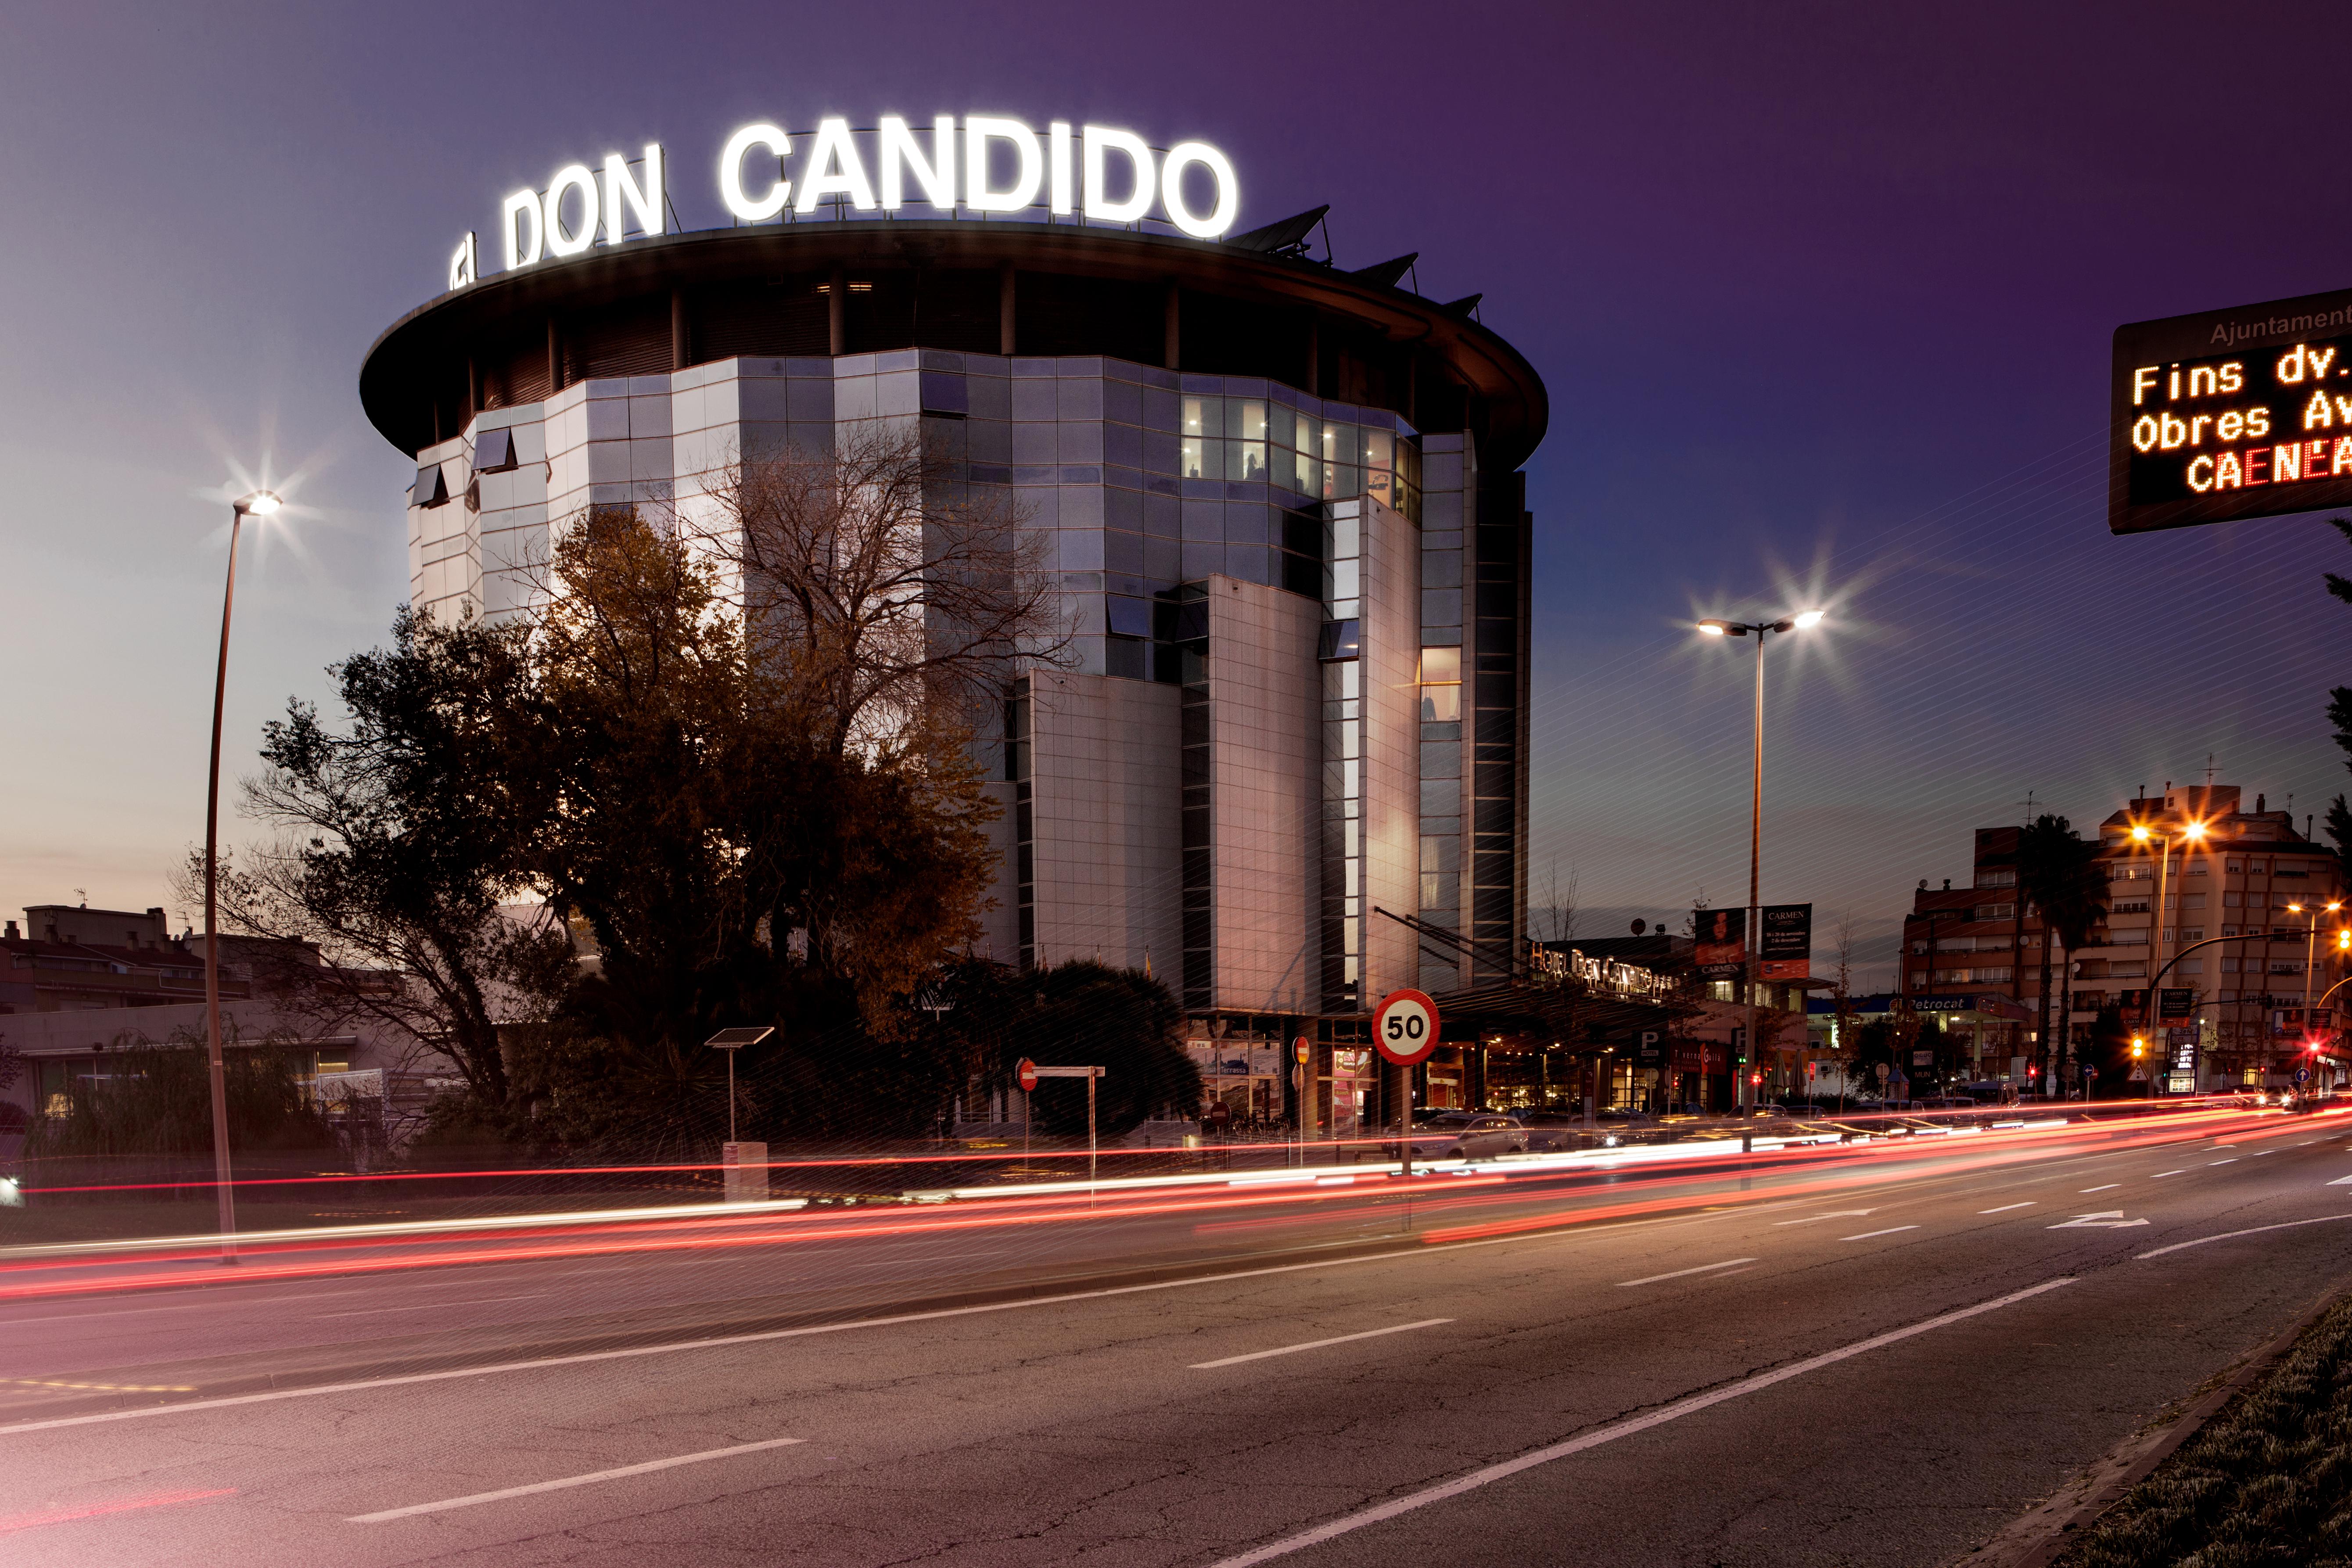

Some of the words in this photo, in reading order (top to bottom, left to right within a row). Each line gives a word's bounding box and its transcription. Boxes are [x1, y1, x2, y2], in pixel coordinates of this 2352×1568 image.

[504, 144, 666, 270] DON
[720, 117, 1237, 239] CANDIDO
[2210, 305, 2352, 347] Ajuntament
[2134, 362, 2242, 405] Fins
[2278, 344, 2348, 383] dv.
[2133, 407, 2269, 452] Obres
[1768, 911, 1804, 920] CARMEN
[1701, 964, 1739, 974] CARMEN
[1908, 999, 1964, 1009] Petrocat
[1387, 1015, 1424, 1040] 50
[1641, 1032, 1659, 1049] P
[1675, 1049, 1700, 1060] Tverna
